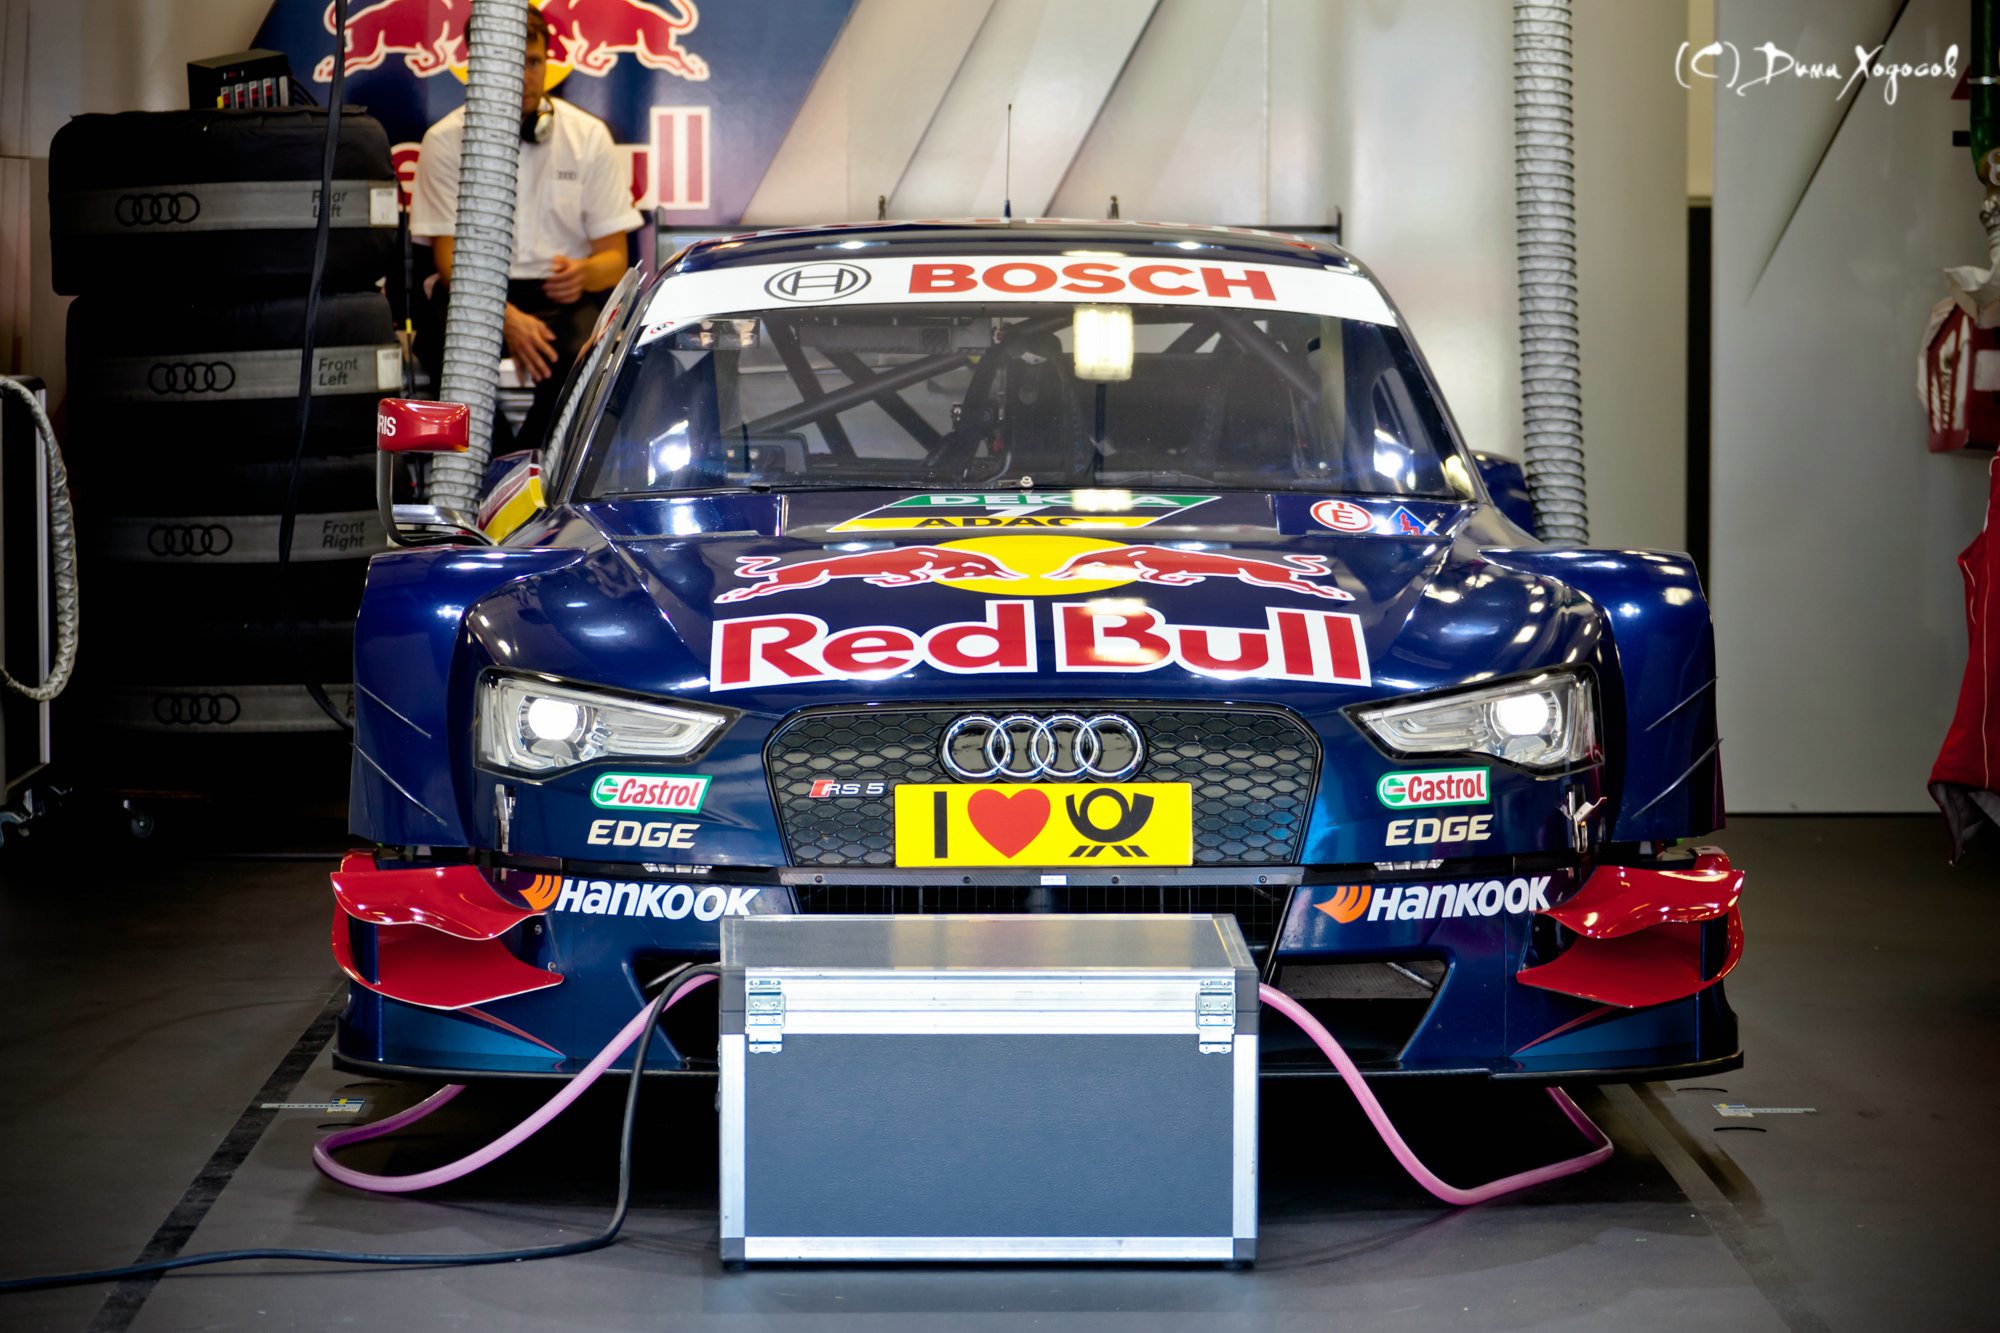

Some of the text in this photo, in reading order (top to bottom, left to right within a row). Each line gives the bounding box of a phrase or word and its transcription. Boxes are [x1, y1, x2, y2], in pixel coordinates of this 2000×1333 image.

[909, 262, 1277, 301] BOSCH
[318, 357, 358, 371] Front
[318, 371, 348, 386] Left
[322, 520, 365, 534] Front
[913, 517, 1085, 528] ADAC
[322, 534, 364, 551] Right
[718, 602, 1364, 687] Red Bull
[618, 778, 700, 807] Castrol
[821, 782, 885, 796] RS 5
[1408, 774, 1485, 803] Castrol
[587, 819, 701, 849] EDGE
[1385, 814, 1494, 847] EDGE
